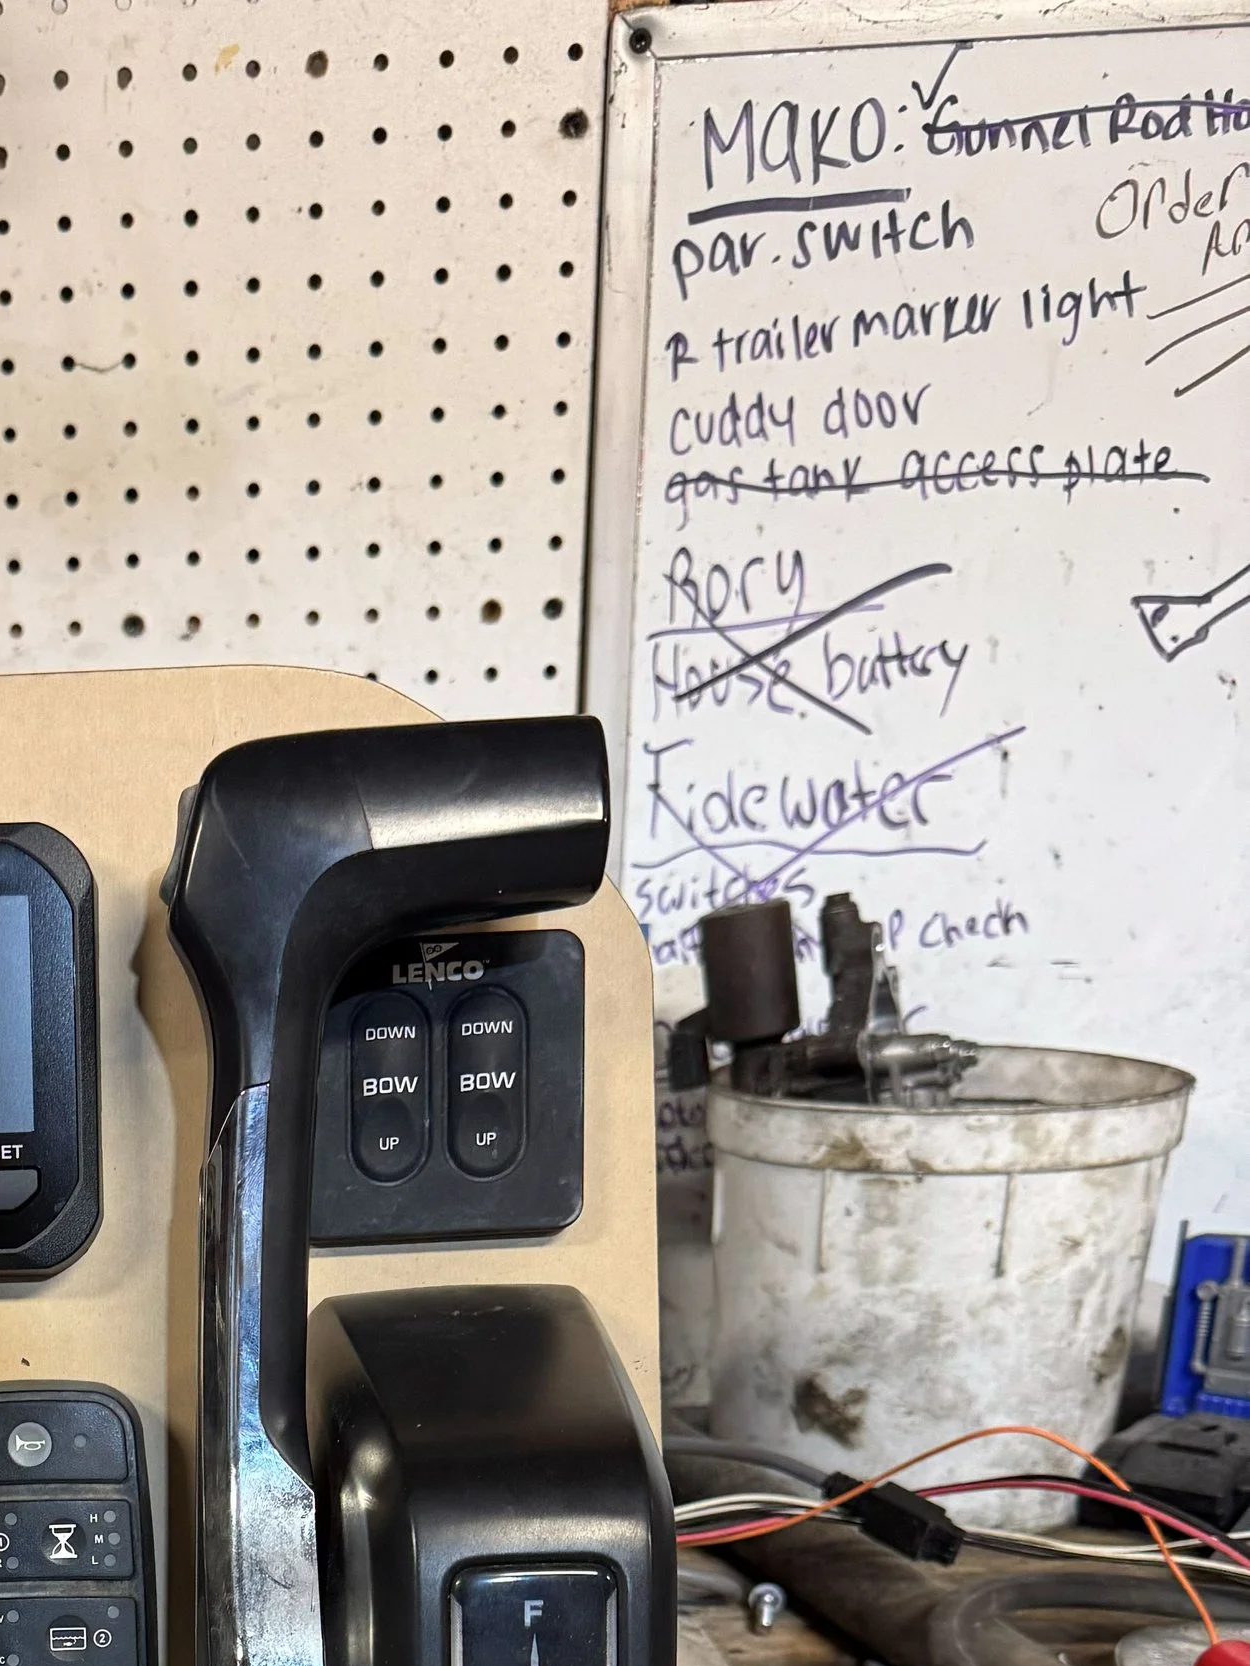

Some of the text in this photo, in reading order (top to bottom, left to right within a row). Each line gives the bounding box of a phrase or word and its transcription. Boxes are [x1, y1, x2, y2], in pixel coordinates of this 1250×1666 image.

[1110, 92, 1193, 144] Rod
[666, 337, 698, 382] R
[711, 318, 840, 369] trailer
[1023, 270, 1148, 347] light
[669, 384, 932, 456] cuddy door
[392, 960, 484, 985] LENCO
[365, 1025, 416, 1041] DOWN
[461, 1020, 513, 1036] DOWN
[363, 1076, 418, 1097] BOW
[460, 1071, 516, 1093] BOW
[379, 1136, 399, 1151] UP
[476, 1132, 497, 1146] UP
[90, 1514, 98, 1523] H
[94, 1535, 104, 1544] M
[91, 1556, 98, 1565] L
[523, 1600, 544, 1627] F
